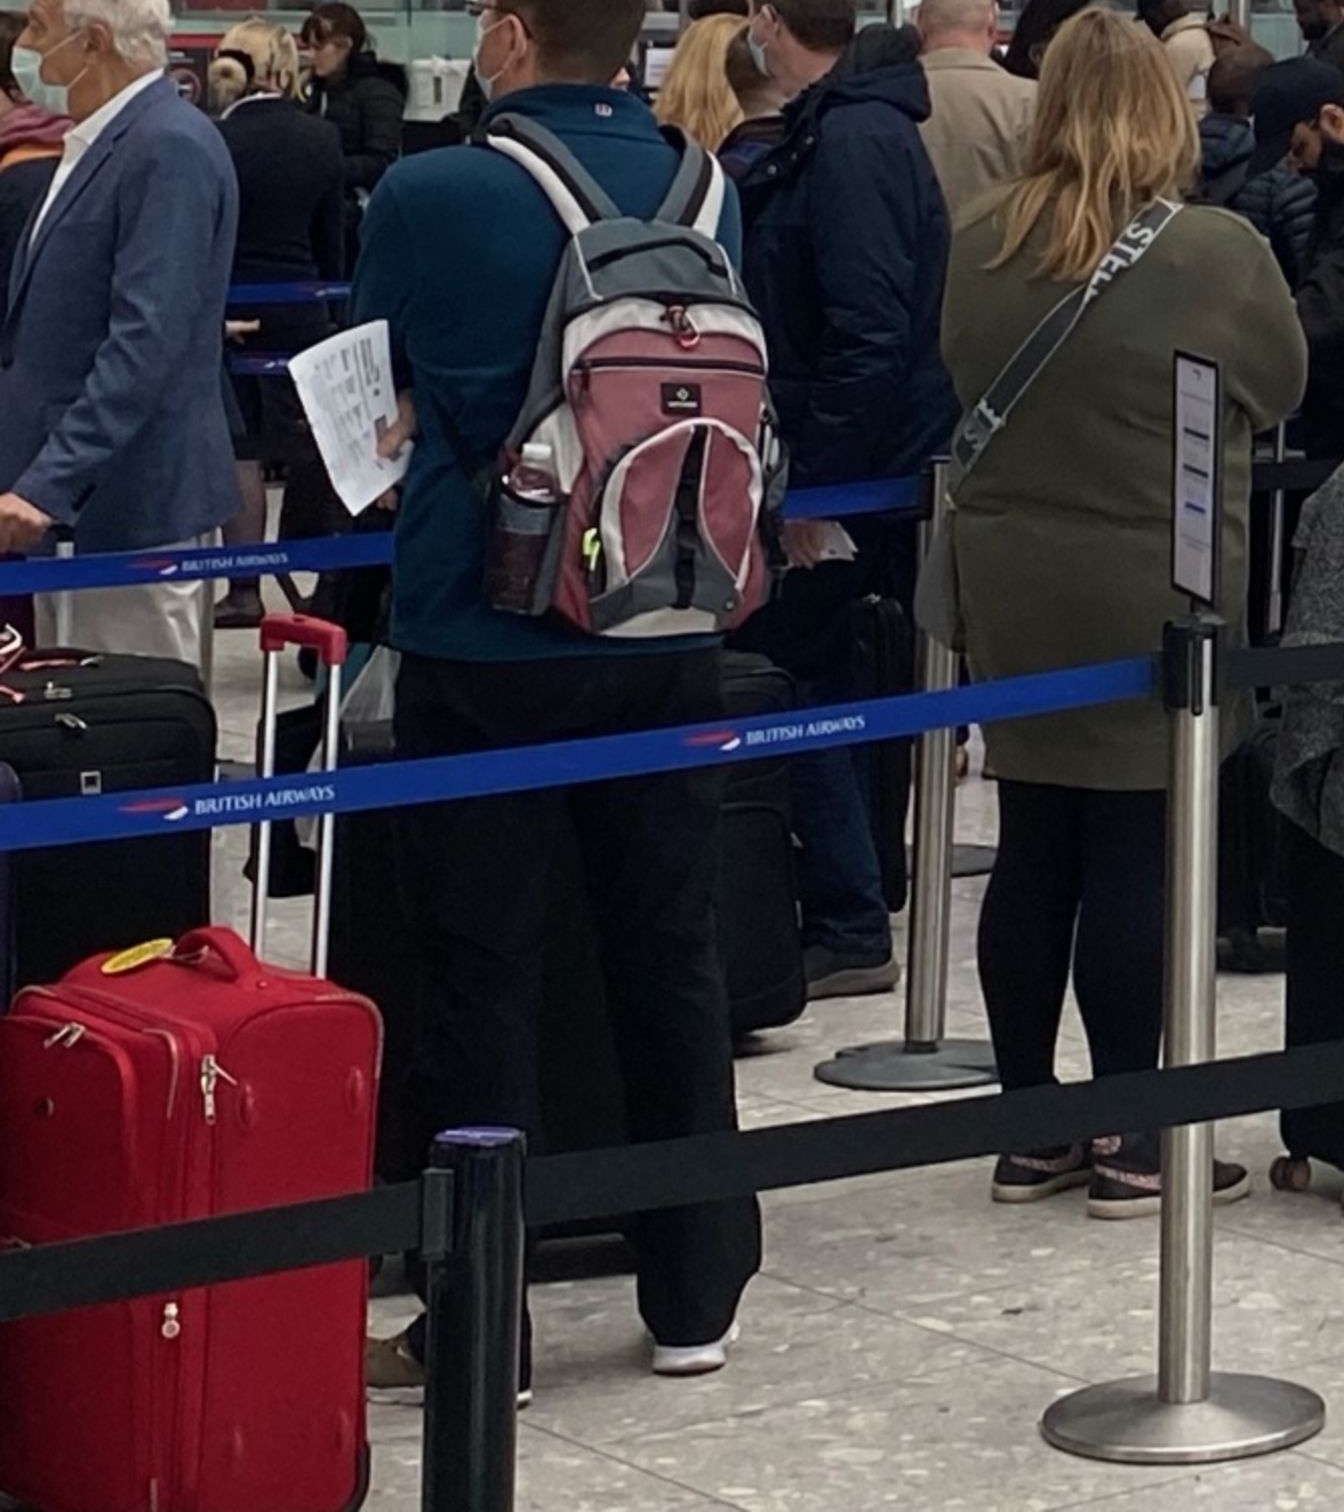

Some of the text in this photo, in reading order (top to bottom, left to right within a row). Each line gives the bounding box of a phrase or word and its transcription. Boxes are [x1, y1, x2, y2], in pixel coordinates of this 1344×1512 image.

[746, 714, 866, 746] BRITISH AIRWAYS
[195, 785, 336, 816] BRITISH AIRWAYS
